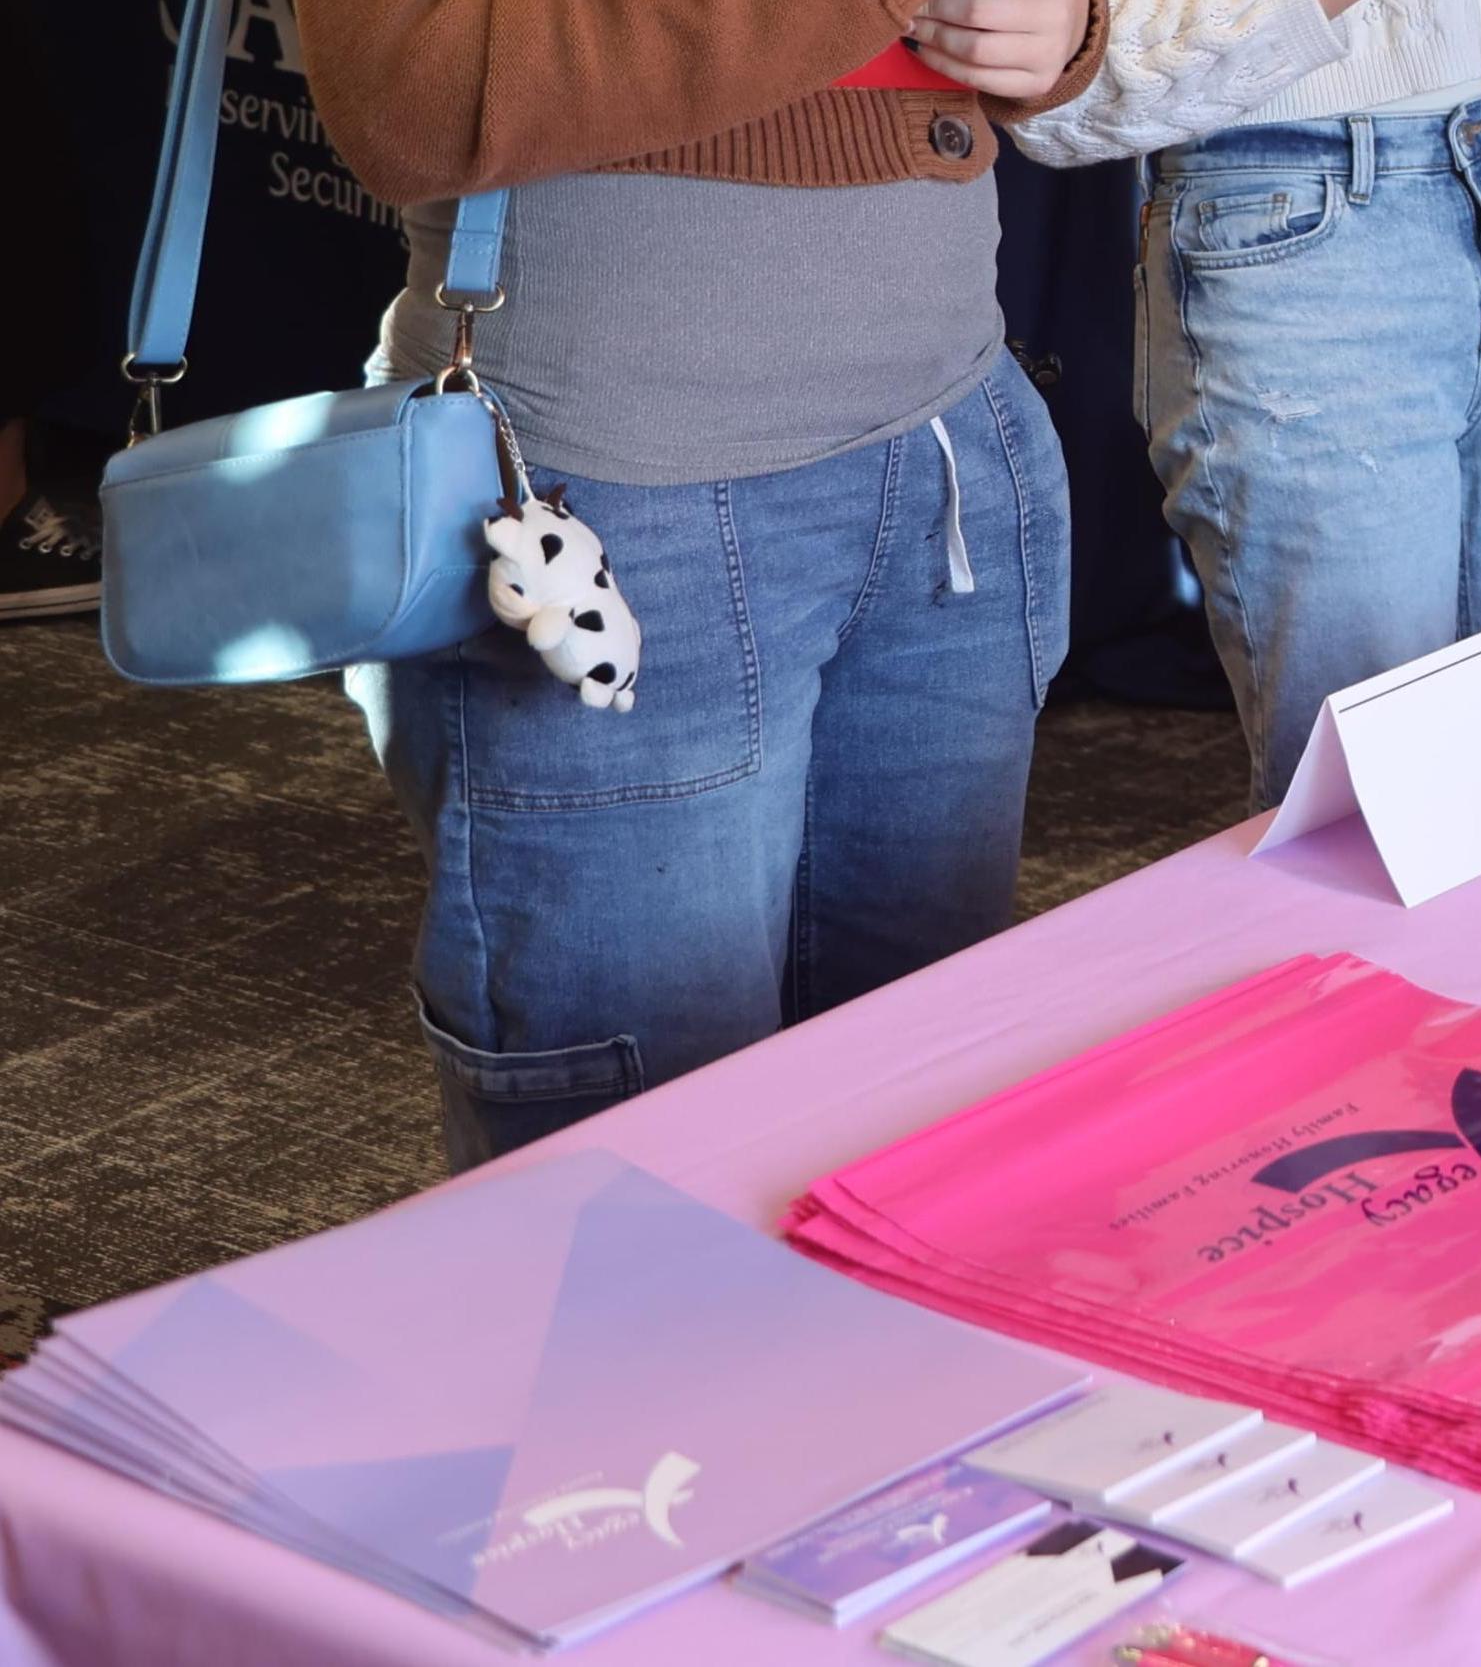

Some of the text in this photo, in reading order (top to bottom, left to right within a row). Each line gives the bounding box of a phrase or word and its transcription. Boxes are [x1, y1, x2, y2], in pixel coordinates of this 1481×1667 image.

[1108, 1100, 1360, 1232] Family Honoring Families
[1194, 1168, 1379, 1266] Hospice
